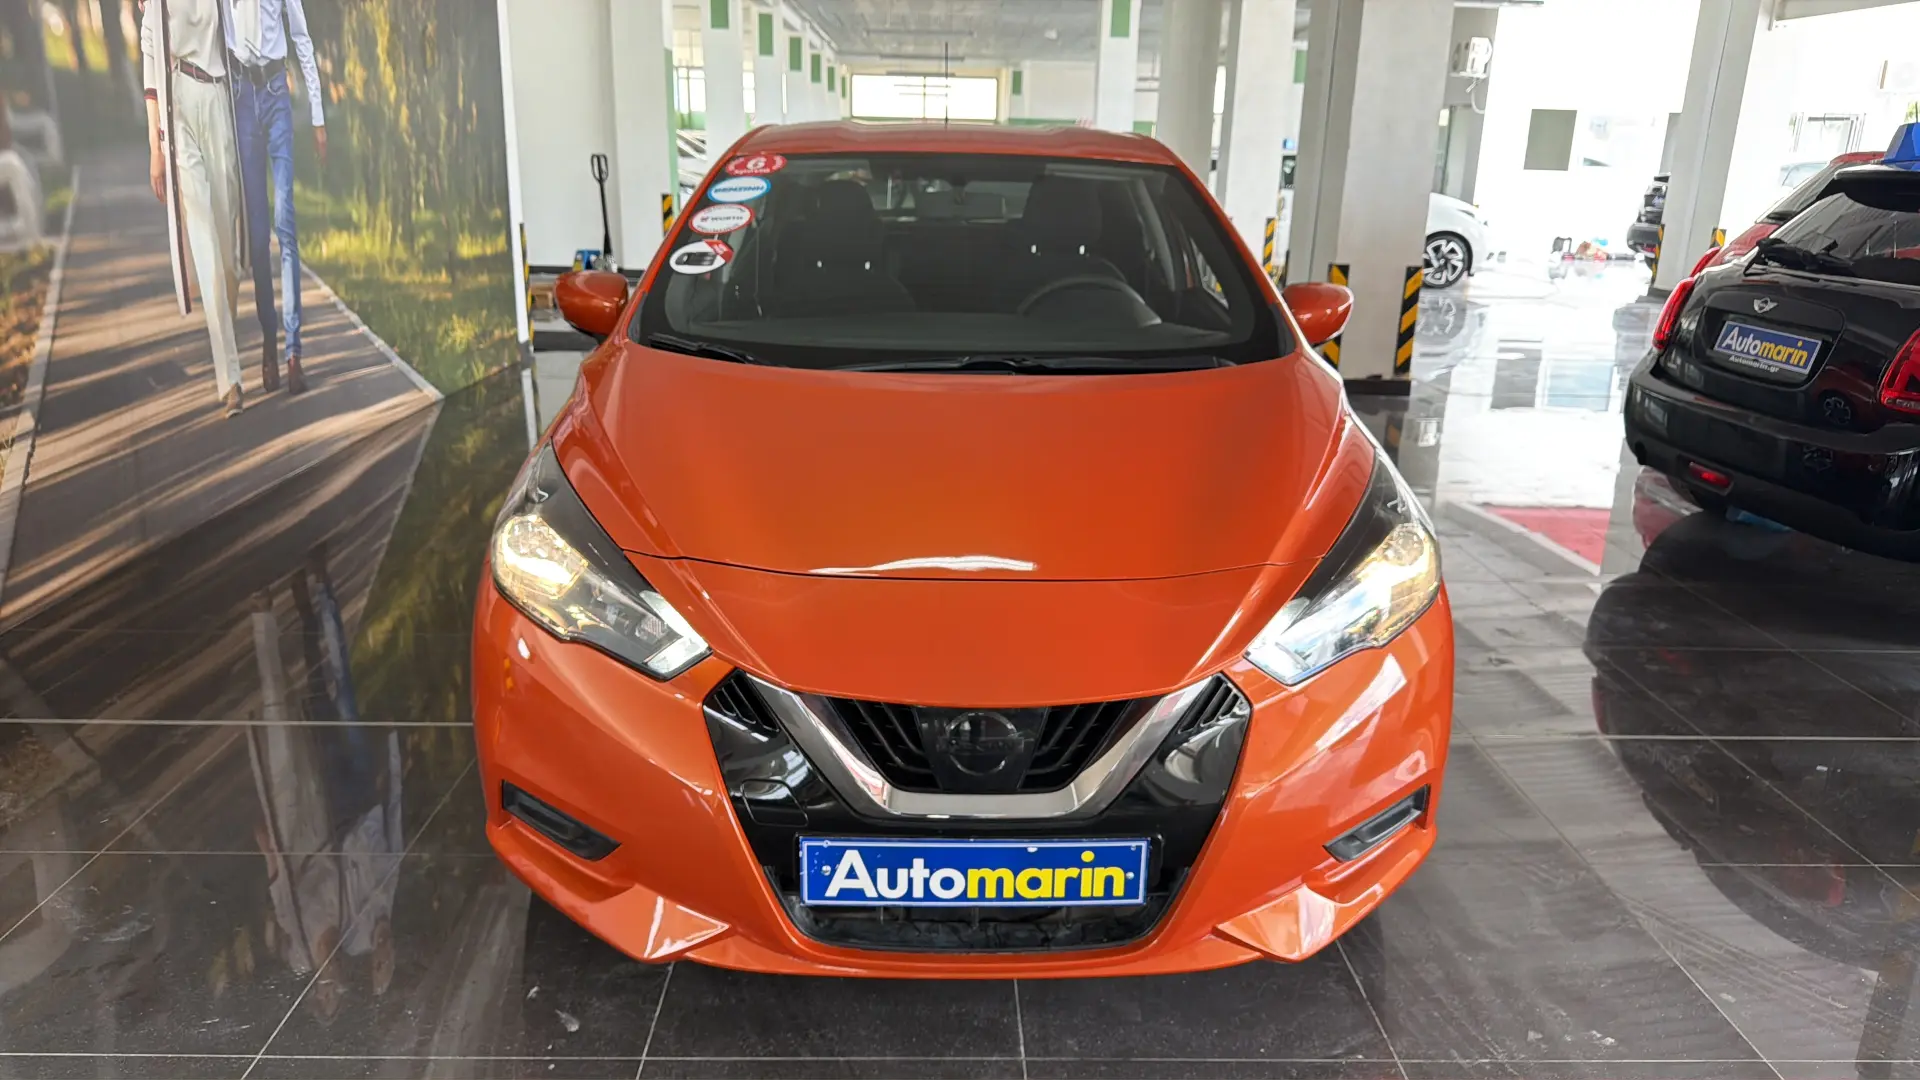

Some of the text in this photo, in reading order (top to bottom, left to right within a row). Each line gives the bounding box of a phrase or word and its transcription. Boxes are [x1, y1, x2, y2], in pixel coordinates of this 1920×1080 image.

[1722, 327, 1808, 366] Automarin
[1729, 355, 1779, 373] Automarin.gr
[824, 849, 1125, 899] Automarin
